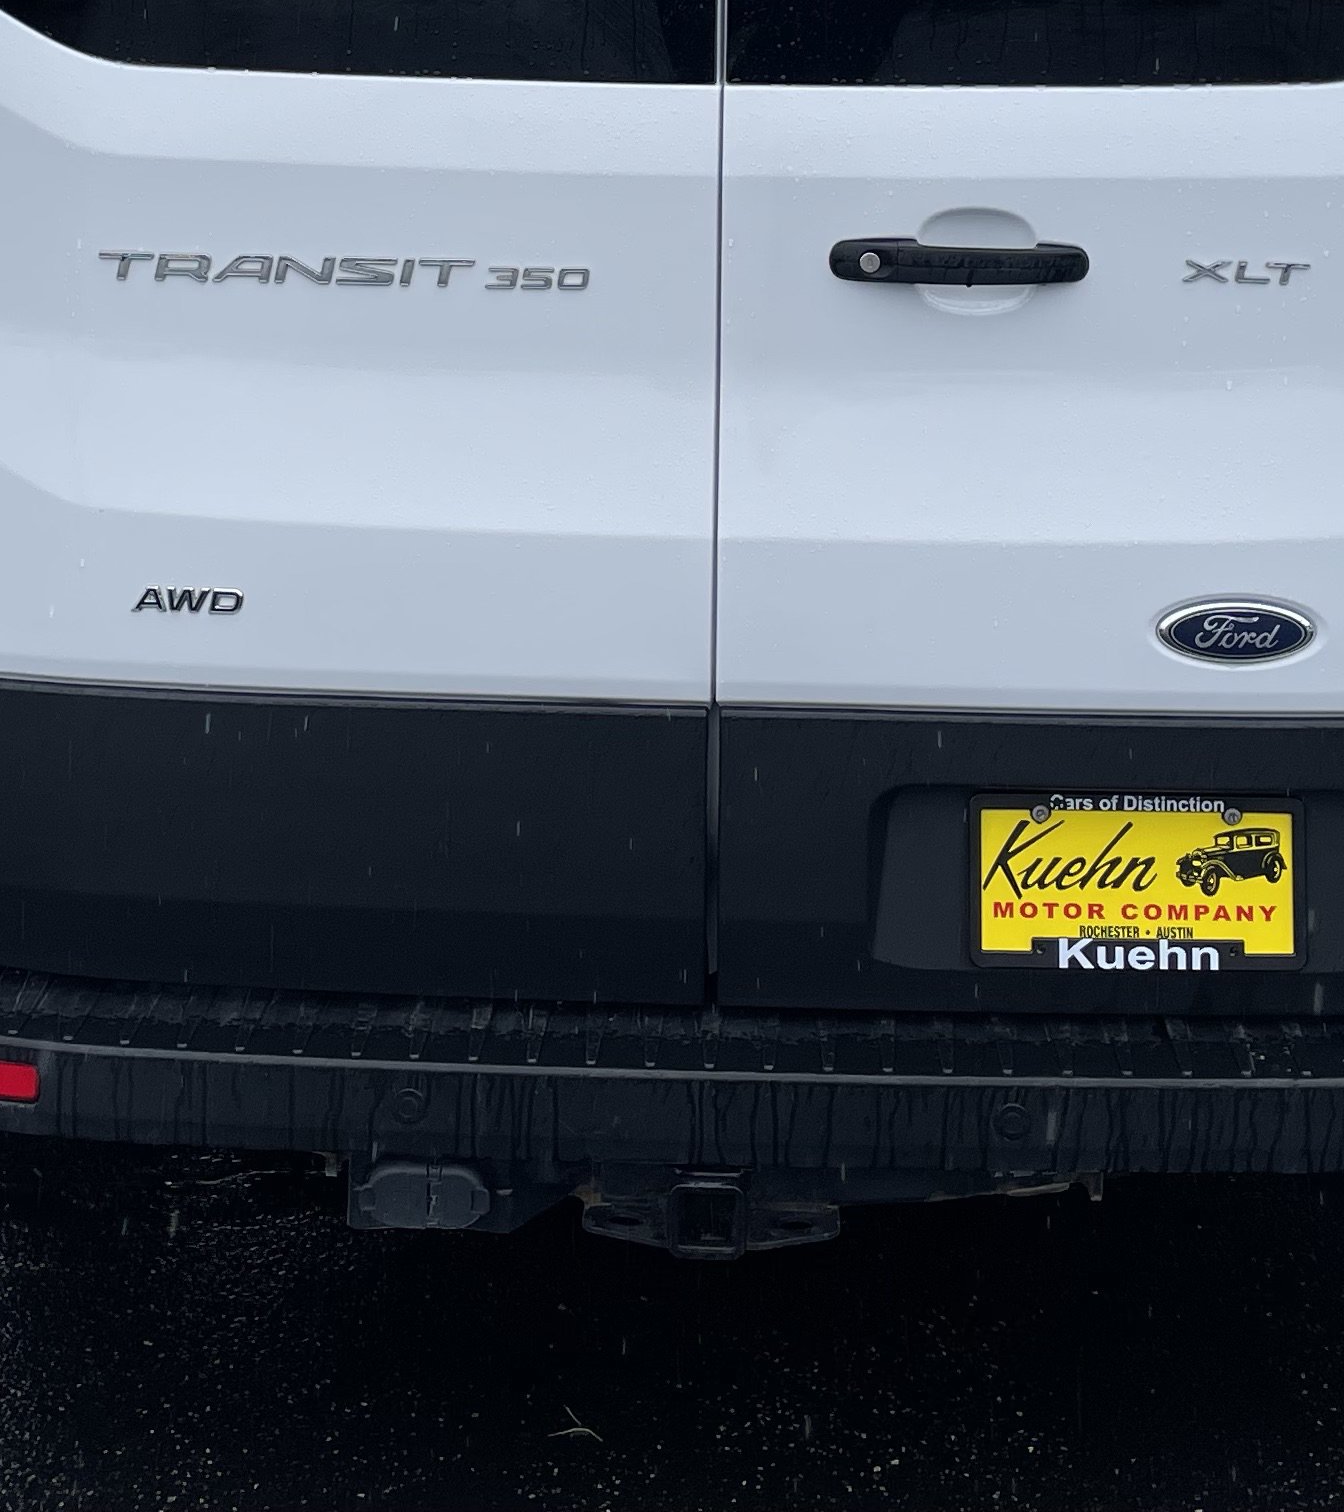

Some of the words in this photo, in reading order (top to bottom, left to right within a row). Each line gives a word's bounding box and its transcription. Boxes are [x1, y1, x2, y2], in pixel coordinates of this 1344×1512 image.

[98, 250, 476, 287] TRANSIT
[485, 266, 590, 290] 350
[1182, 259, 1312, 286] XLT
[130, 584, 245, 615] AWD
[1194, 614, 1281, 649] Ford
[1049, 793, 1093, 811] Cars
[1098, 795, 1119, 811] of
[1123, 795, 1225, 812] Distinction
[982, 819, 1158, 900] Kuehn
[993, 901, 1105, 920] MOTOR
[1121, 903, 1278, 922] COMPANY
[1079, 925, 1140, 938] ROCHESTER
[1156, 926, 1194, 939] AUSTIN
[1058, 937, 1220, 971] Kuehn
